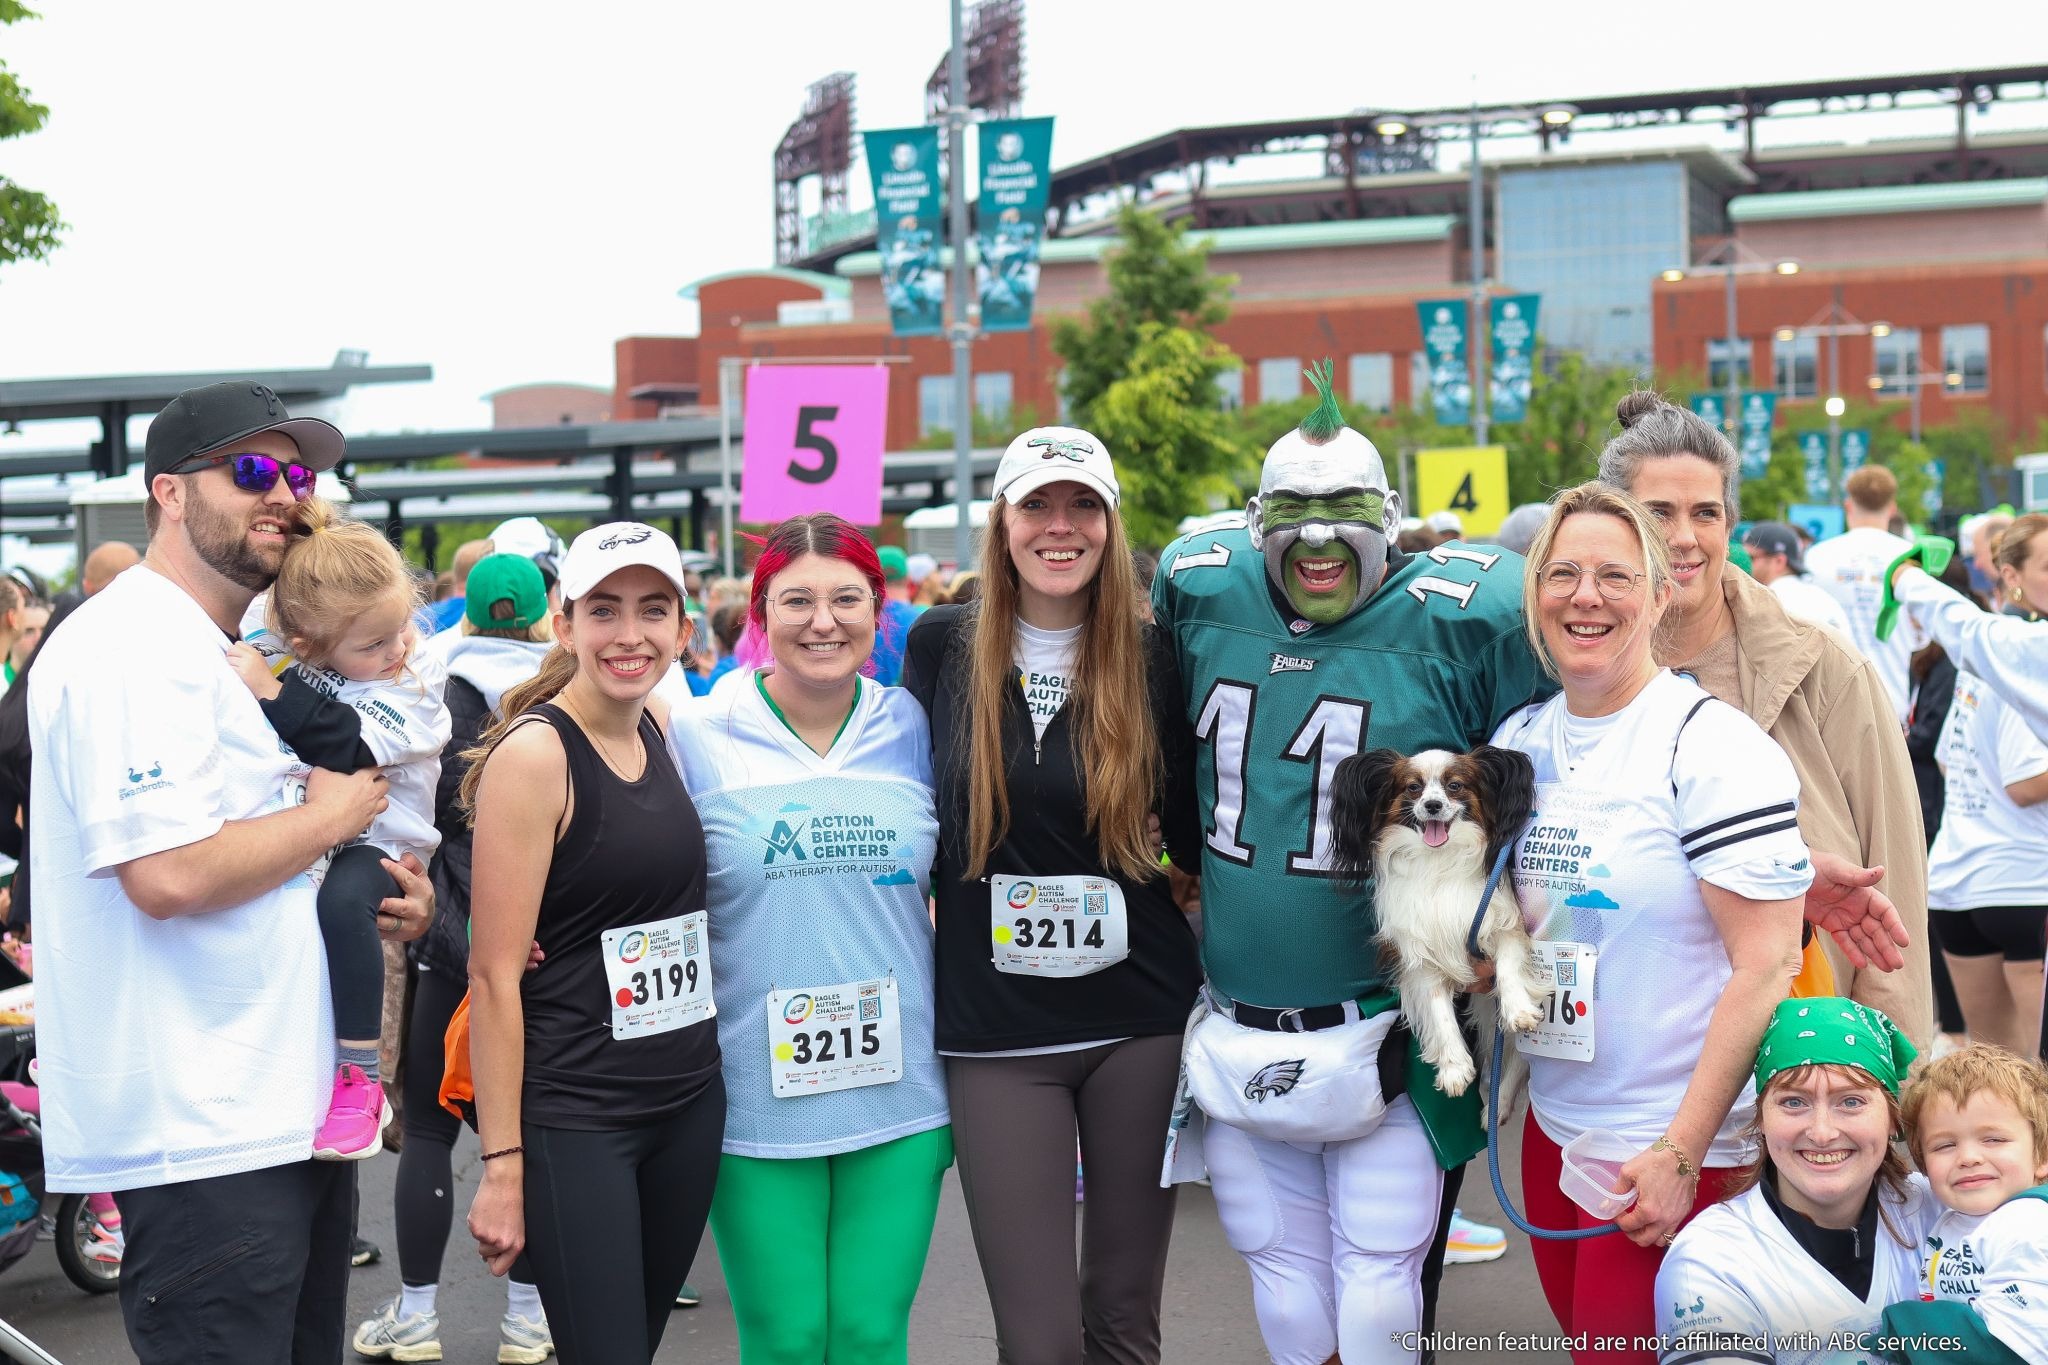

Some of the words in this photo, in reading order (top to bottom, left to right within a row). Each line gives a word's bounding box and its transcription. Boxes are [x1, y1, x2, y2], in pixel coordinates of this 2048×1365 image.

[787, 406, 839, 485] 5
[1449, 471, 1478, 512] 4
[1268, 652, 1319, 675] EAGLES
[1027, 688, 1070, 702] AUTI
[355, 700, 391, 729] EAGLES
[1195, 678, 1374, 880] 11
[811, 815, 875, 829] ACTION
[811, 829, 897, 844] BEHAVIOR
[1528, 826, 1578, 841] ACTION
[813, 844, 889, 859] CENTERS
[1523, 840, 1592, 859] BEHAVIOR
[764, 871, 785, 881] ABA
[788, 865, 834, 878] THERAPY
[837, 864, 857, 873] FOR
[859, 864, 897, 873] AUTISM
[1520, 856, 1579, 874] CENTERS
[1535, 878, 1549, 889] FOR
[1551, 880, 1586, 893] AUTISM
[648, 929, 669, 938] EAGLES
[649, 935, 670, 946] AUTISM
[1014, 917, 1105, 949] 3214
[649, 940, 681, 952] CHALLENGE
[631, 959, 699, 1006] 3199
[814, 993, 841, 1002] EAGLES
[815, 1000, 841, 1008] AUTISM
[815, 1004, 855, 1015] CHALLENGE
[1539, 990, 1576, 1026] 16
[792, 1023, 880, 1065] 3215
